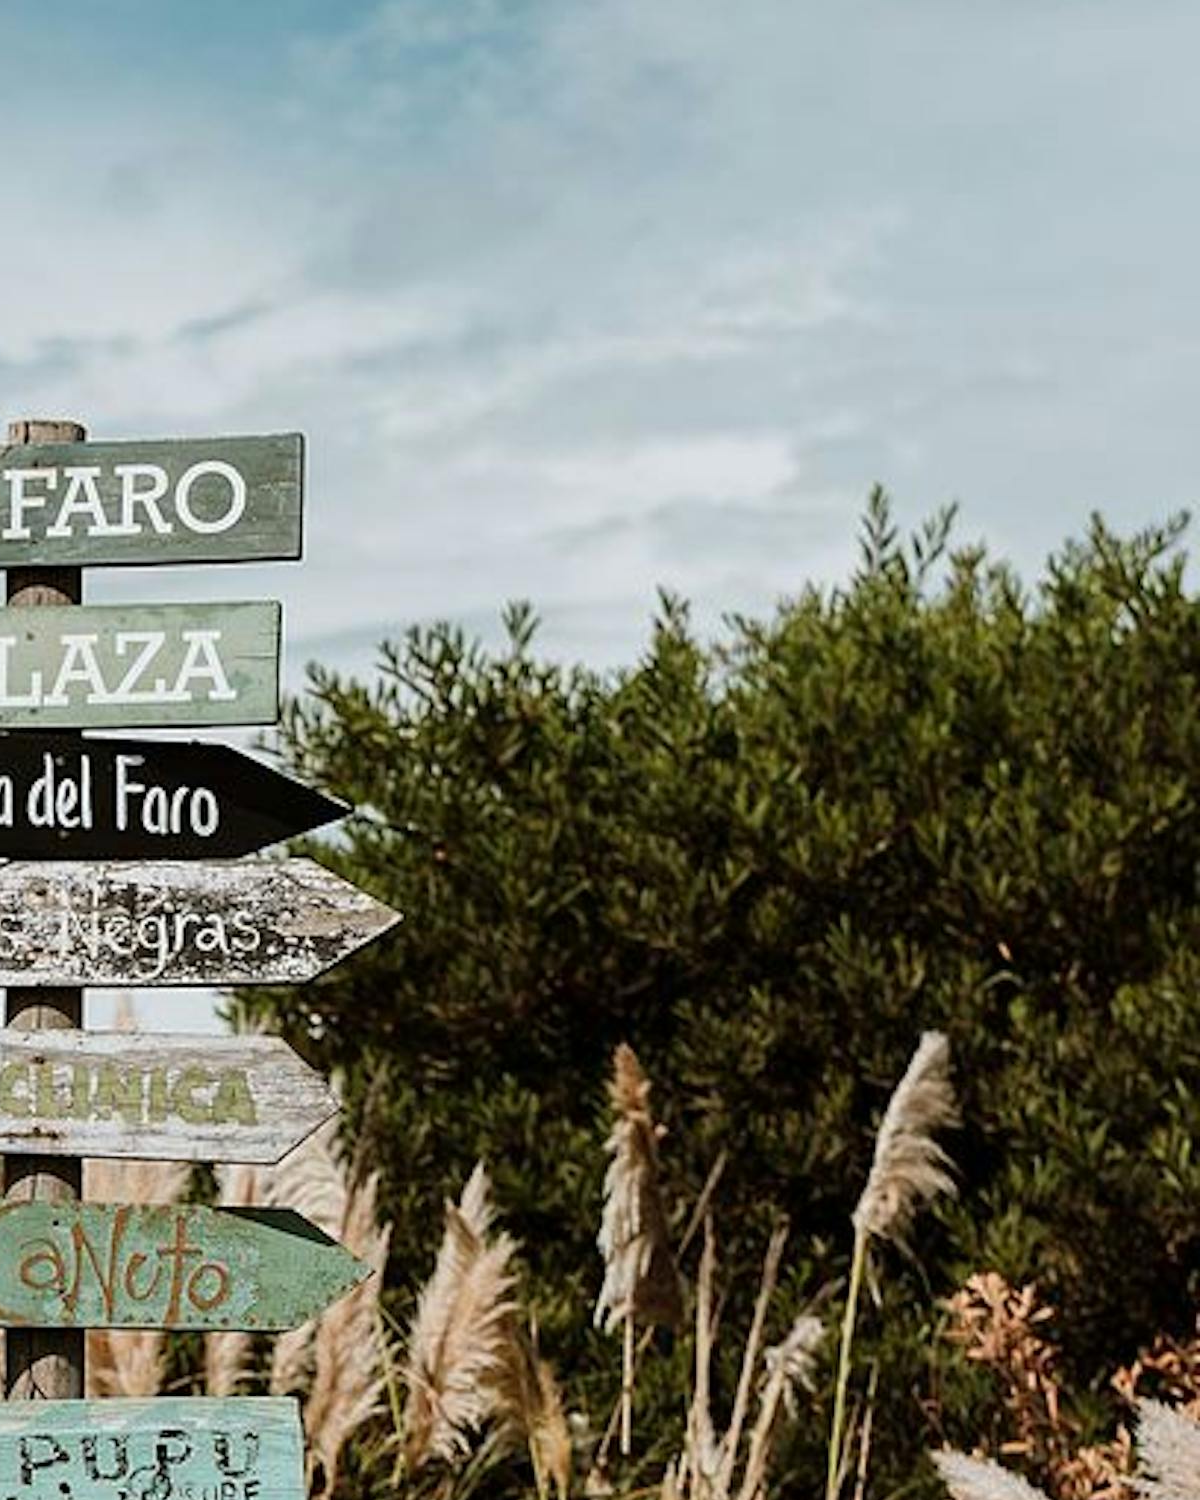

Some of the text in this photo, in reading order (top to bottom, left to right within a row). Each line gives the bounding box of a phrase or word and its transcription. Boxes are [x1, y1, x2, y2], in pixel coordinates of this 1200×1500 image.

[2, 461, 248, 540] FARO
[27, 753, 93, 830] del
[116, 754, 220, 838] Faro
[61, 878, 262, 979] Negras
